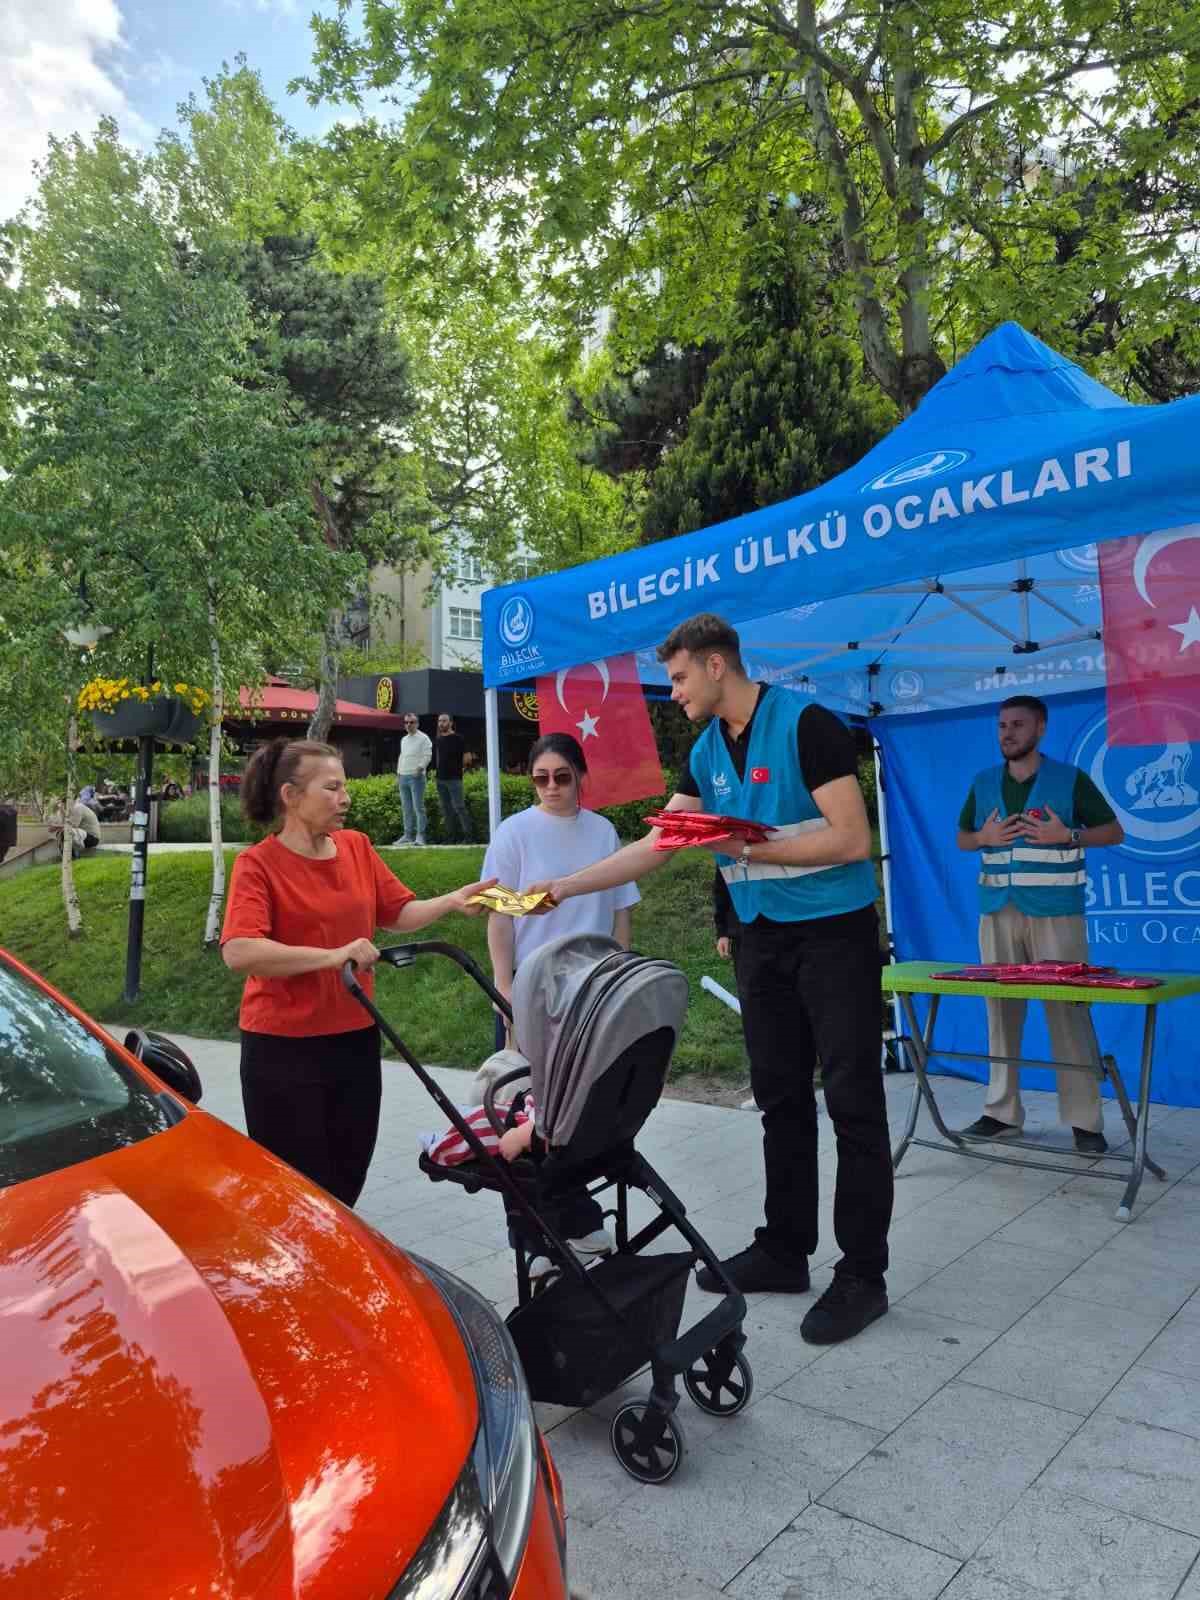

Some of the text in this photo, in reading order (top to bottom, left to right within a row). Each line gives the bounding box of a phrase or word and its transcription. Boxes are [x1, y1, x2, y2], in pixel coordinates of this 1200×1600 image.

[587, 440, 1131, 620] BİLECİK ÜLKÜ OCAKLARI
